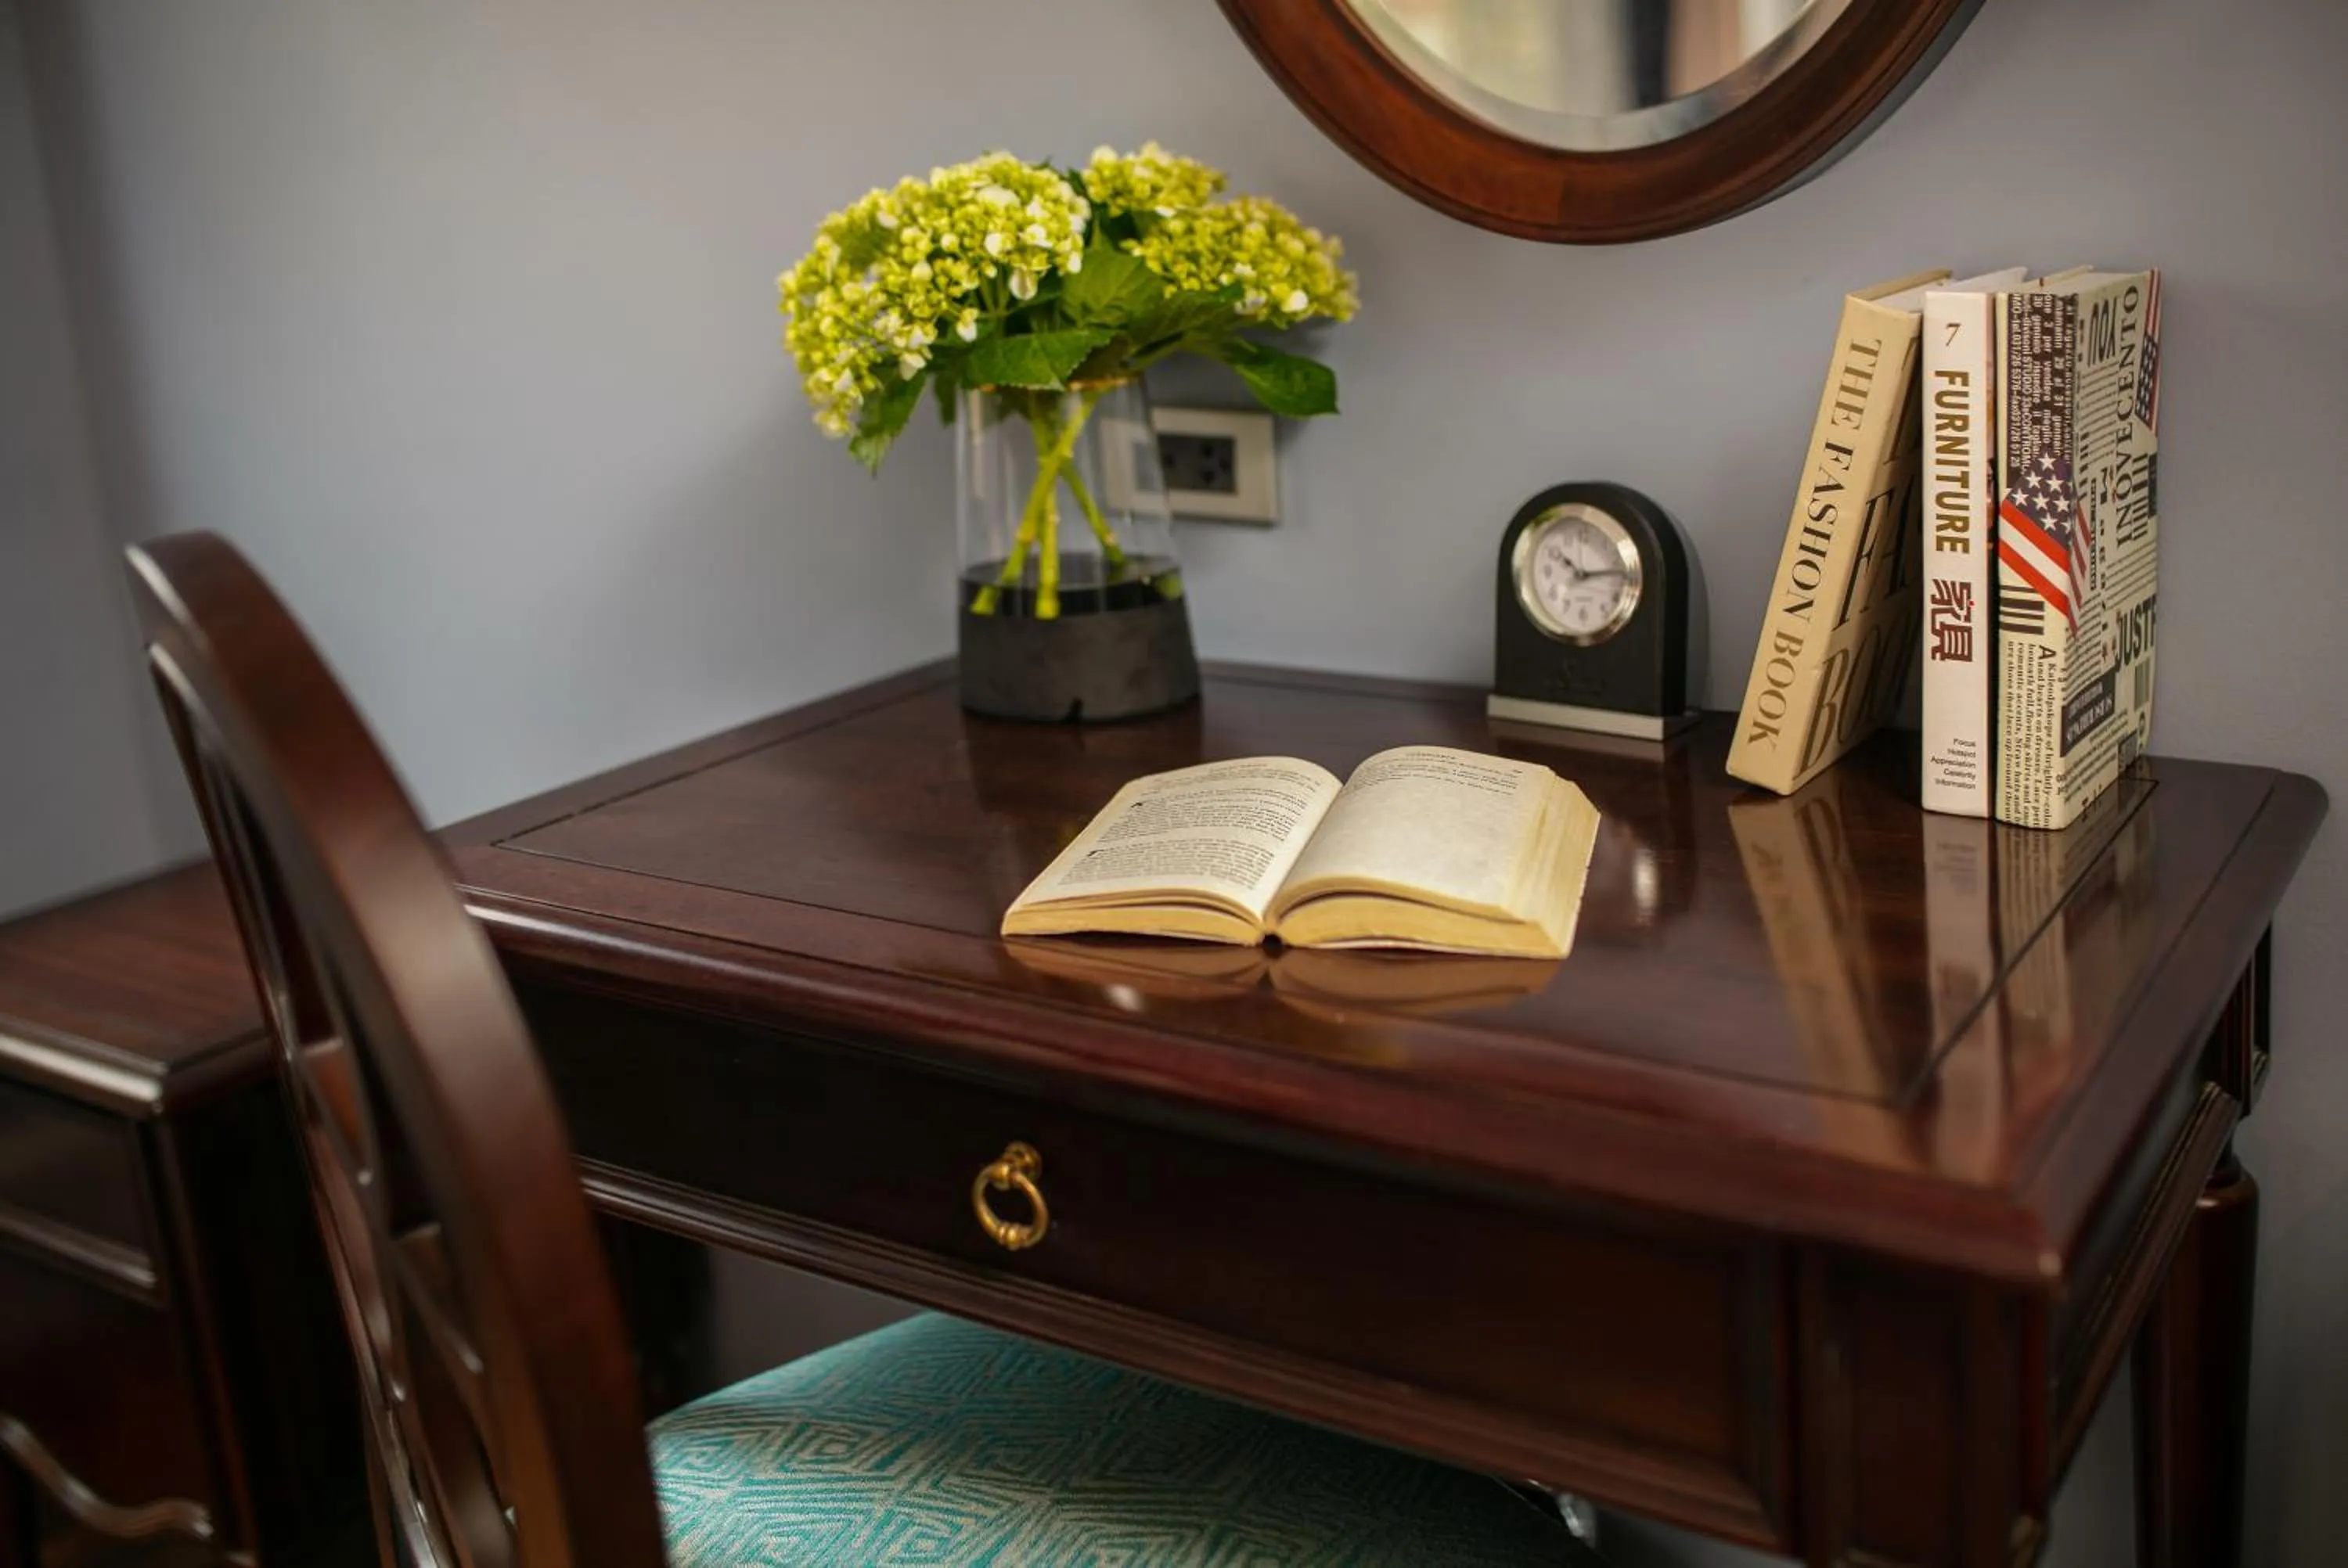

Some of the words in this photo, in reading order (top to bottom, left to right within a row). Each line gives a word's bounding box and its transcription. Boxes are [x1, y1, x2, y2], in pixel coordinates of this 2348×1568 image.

[1945, 322, 1961, 347] 7
[2043, 336, 2052, 353] per
[1831, 338, 1882, 430] THE
[2022, 356, 2033, 395] STUDIO
[1934, 369, 1970, 555] FURNITURE
[1784, 438, 1854, 624] FASHION
[1930, 578, 1975, 663] 家具
[2016, 642, 2025, 692] romantic
[2027, 643, 2036, 686] beneath
[2037, 645, 2057, 660] A
[1748, 629, 1805, 752] BOOK
[2036, 684, 2045, 718] hearts
[2046, 740, 2054, 751] of
[2024, 752, 2033, 782] skirts
[2023, 784, 2032, 804] and
